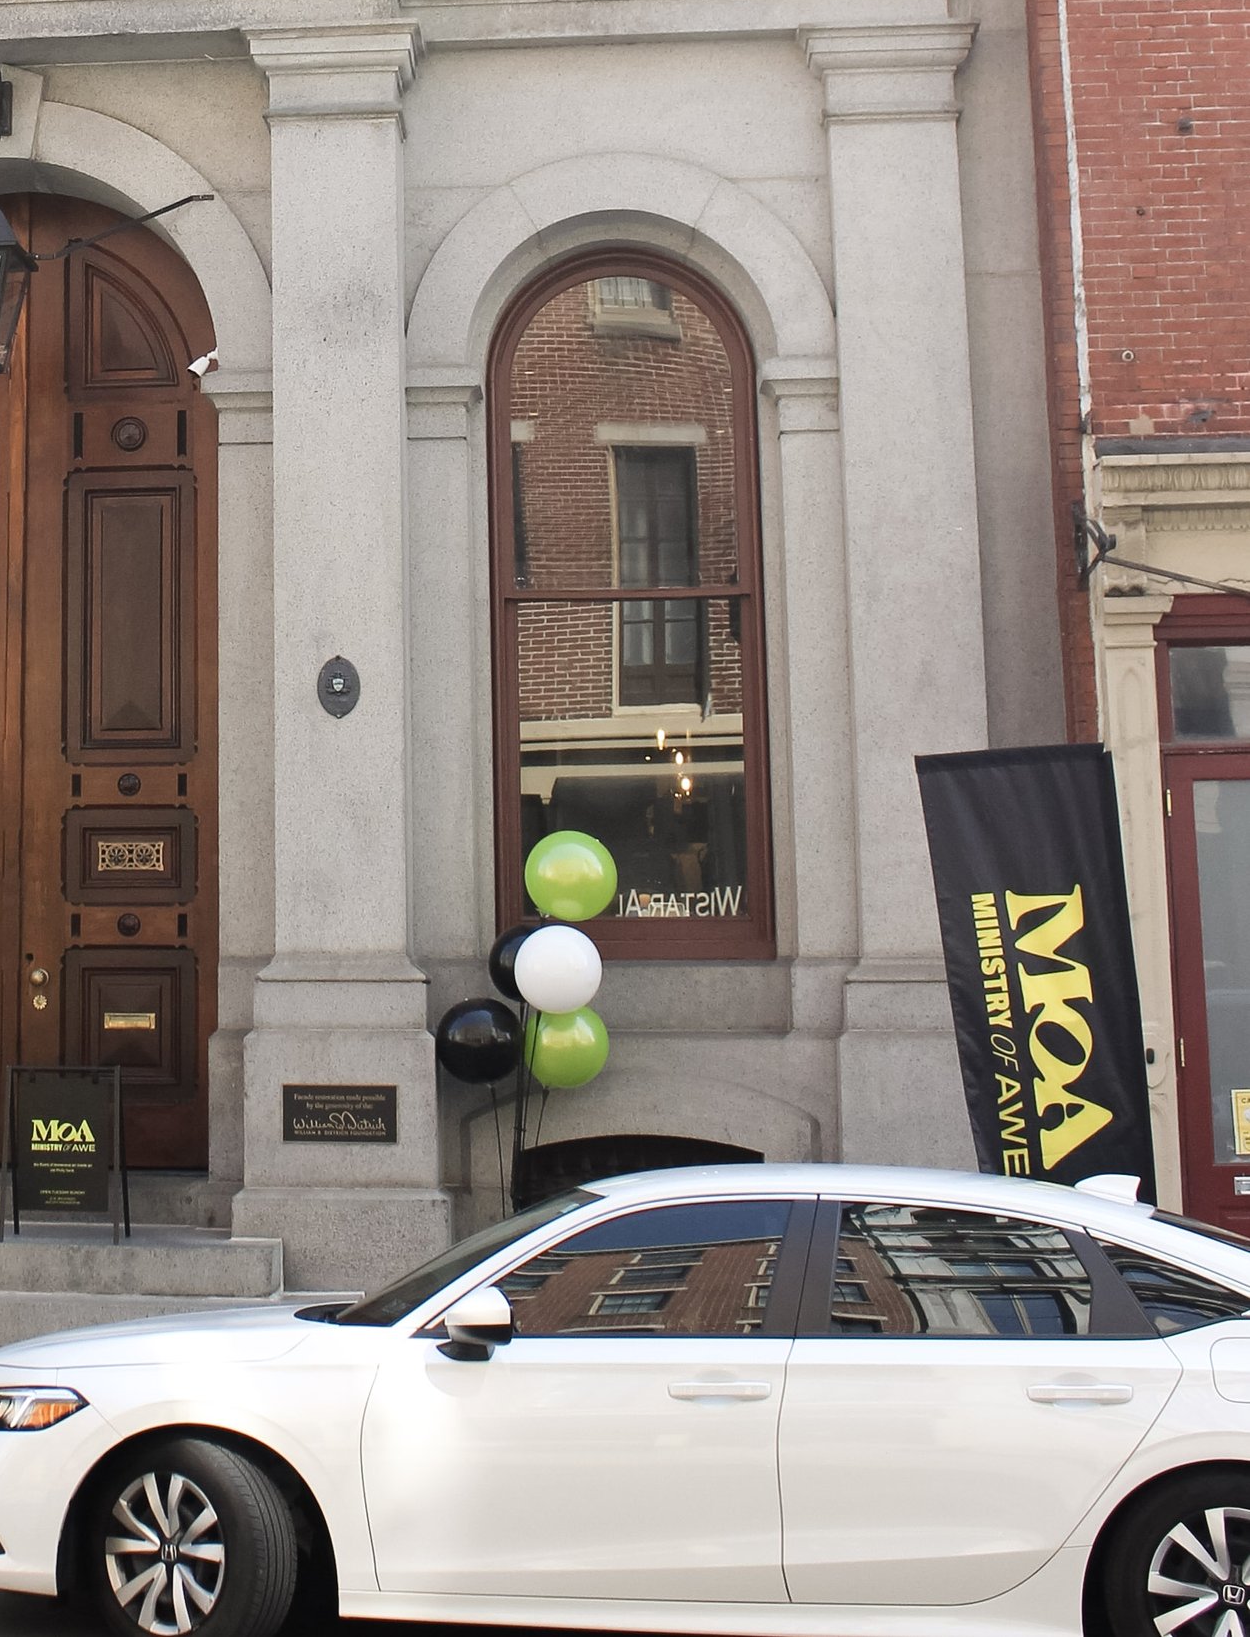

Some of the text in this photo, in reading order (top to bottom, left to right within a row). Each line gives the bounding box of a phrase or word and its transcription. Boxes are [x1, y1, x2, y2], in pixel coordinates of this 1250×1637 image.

[971, 893, 1031, 1176] MINISTRY OF AWE
[31, 1143, 62, 1152] MINISTRY
[72, 1143, 96, 1152] AWE
